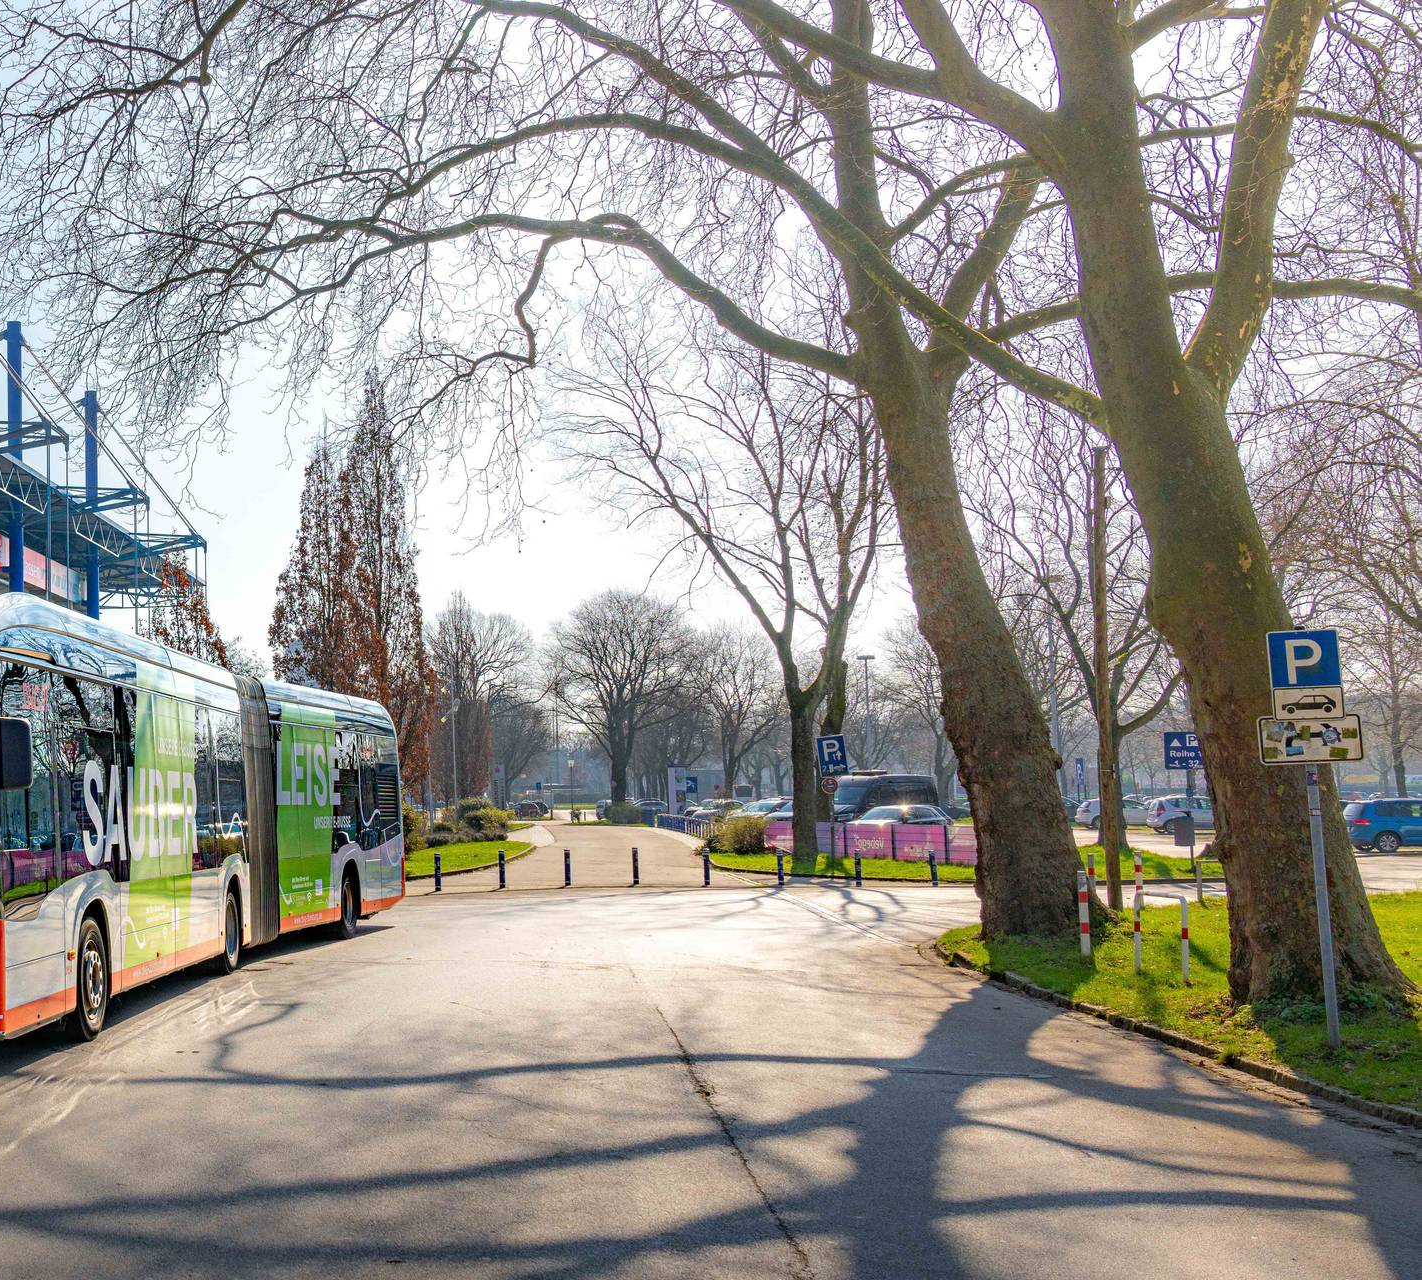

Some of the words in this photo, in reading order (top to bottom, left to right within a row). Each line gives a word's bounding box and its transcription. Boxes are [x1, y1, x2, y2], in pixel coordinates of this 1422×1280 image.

[1284, 638, 1322, 685] P
[276, 740, 341, 807] LEISE
[822, 739, 840, 762] P
[82, 760, 199, 867] SAUBER
